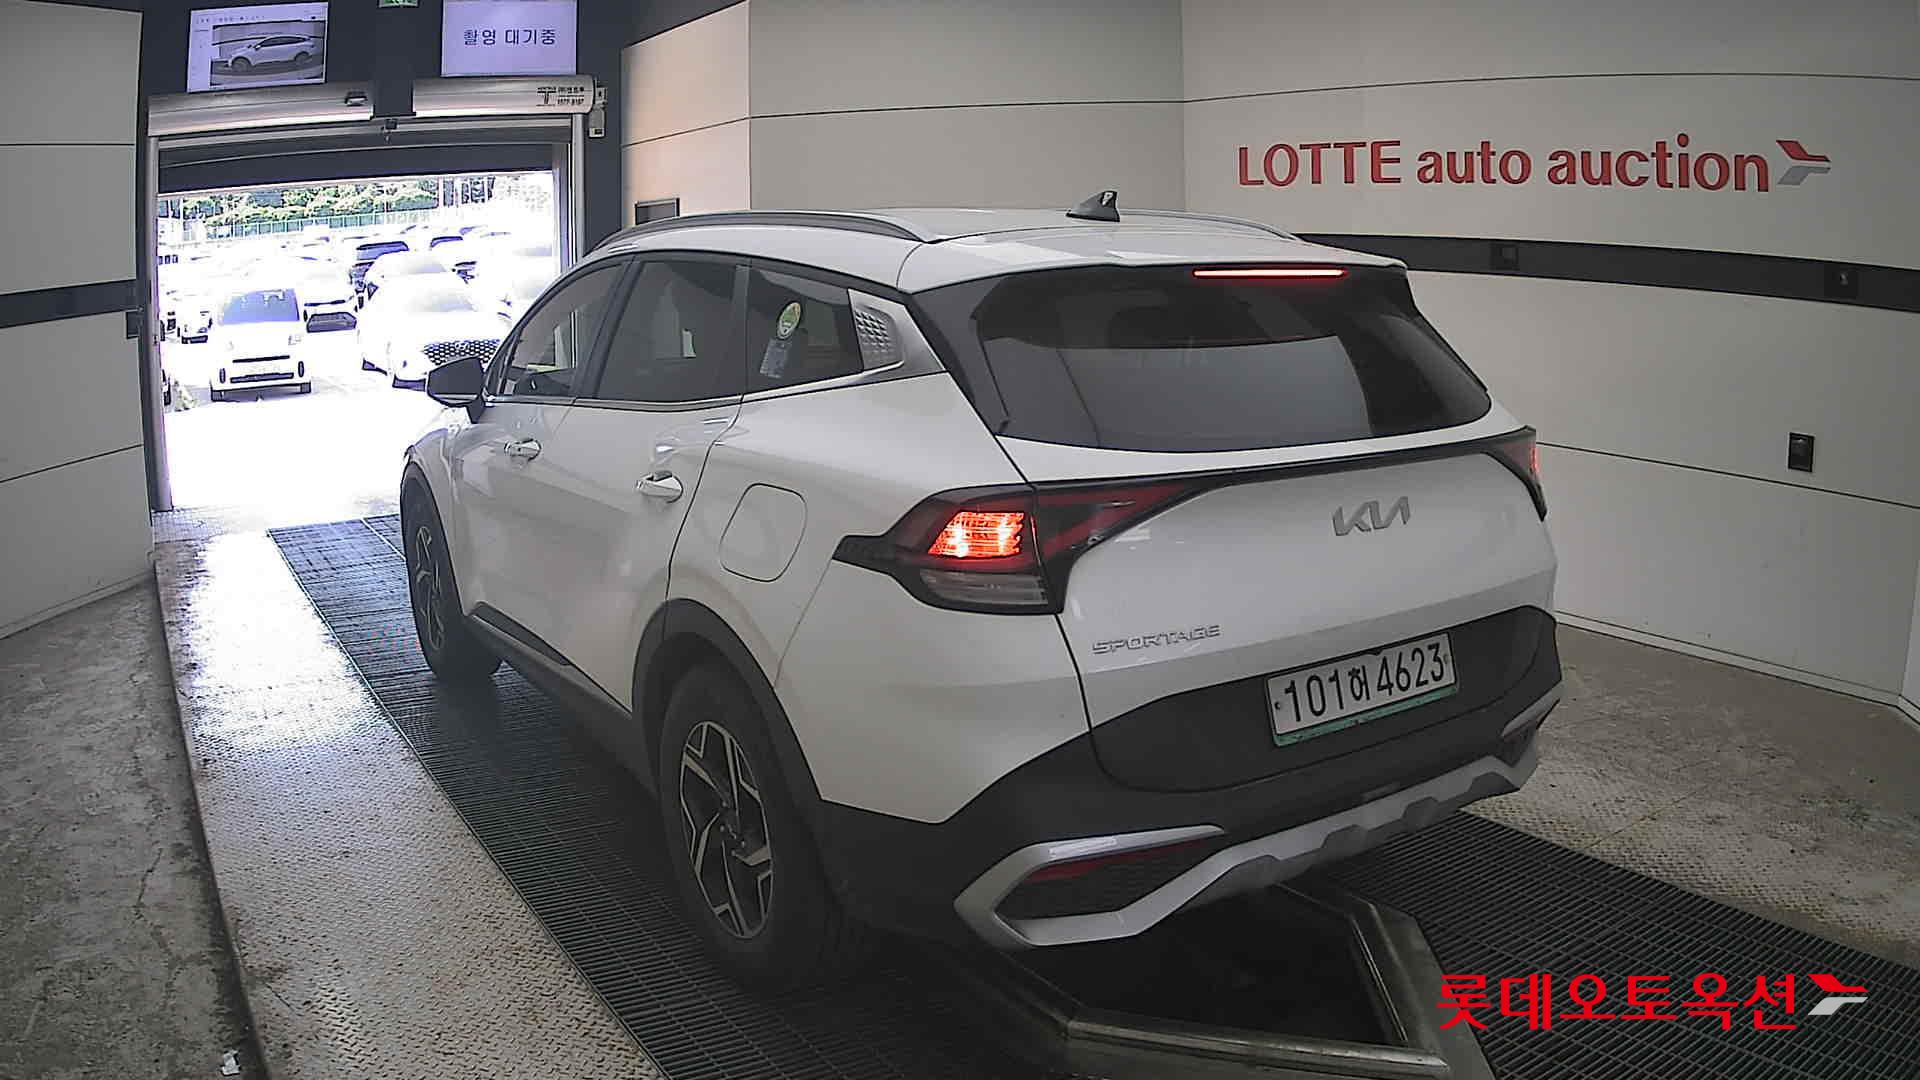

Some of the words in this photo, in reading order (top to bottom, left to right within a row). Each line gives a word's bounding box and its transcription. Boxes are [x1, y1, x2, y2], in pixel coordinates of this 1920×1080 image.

[463, 29, 496, 46] 촬영
[504, 29, 556, 46] 대기중
[1240, 141, 1402, 189] LOTTE
[1417, 142, 1532, 186] auto
[1548, 133, 1770, 192] auction
[1333, 496, 1411, 536] KIA
[1092, 625, 1220, 655] SPORTAGE
